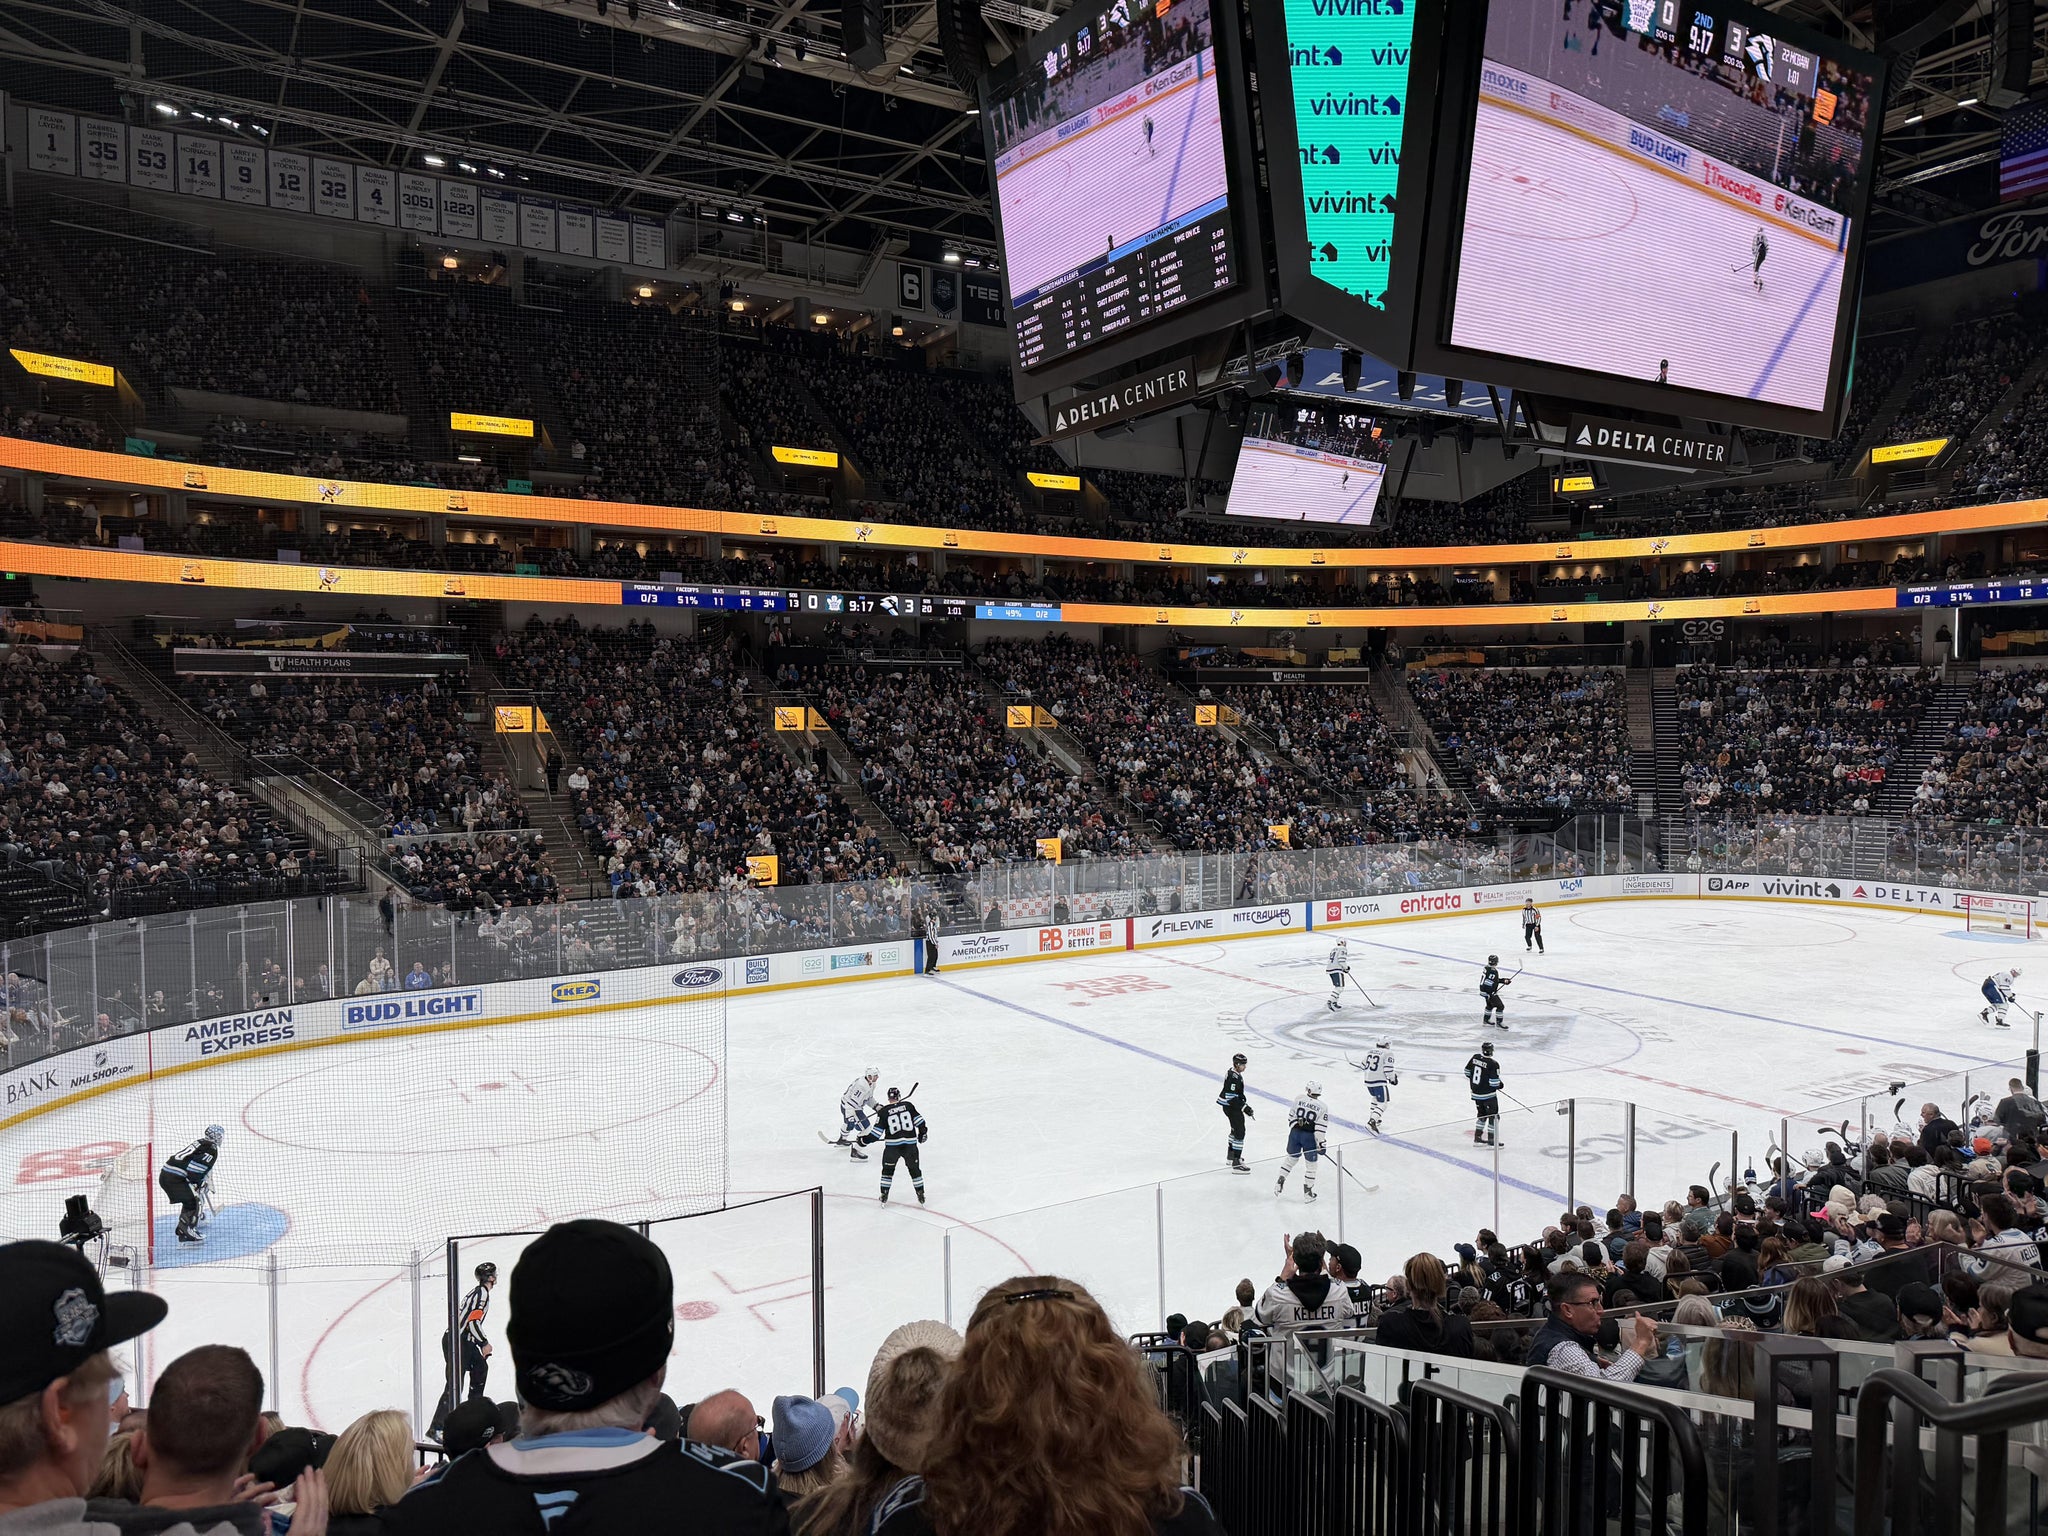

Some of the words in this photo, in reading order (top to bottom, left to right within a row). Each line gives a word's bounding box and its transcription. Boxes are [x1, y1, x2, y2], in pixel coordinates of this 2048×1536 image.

[1694, 11, 1713, 30] 2ND
[1077, 35, 1091, 56] 9:17
[1689, 26, 1713, 55] 9:17
[1731, 27, 1741, 52] 3
[1310, 92, 1379, 116] vivint
[47, 133, 57, 151] 1
[1630, 129, 1654, 151] BUD
[1655, 137, 1688, 167] LIGHT
[88, 140, 118, 162] 35
[137, 148, 166, 170] 53
[188, 157, 211, 177] 14
[238, 166, 252, 184] 9
[279, 172, 300, 192] 12
[321, 180, 347, 200] 32
[371, 188, 383, 206] 4
[402, 192, 435, 210] 3051
[1308, 191, 1376, 214] vivint
[443, 200, 476, 216] 1223
[1784, 196, 1808, 223] Ken
[1806, 207, 1836, 235] Garff
[1967, 206, 2048, 266] For
[902, 272, 920, 301] 6
[1070, 394, 1120, 425] DELTA
[1124, 369, 1189, 406] CENTER
[1596, 427, 1656, 453] DELTA
[1661, 436, 1725, 462] CENTER
[641, 593, 658, 604] 0/3
[677, 594, 699, 605] 51%
[714, 596, 724, 606] 11
[1914, 595, 1931, 605] 0/3
[1950, 592, 1973, 602] 51%
[1989, 590, 2001, 600] 11
[2019, 588, 2032, 598] 12
[740, 598, 752, 608] 12
[763, 599, 775, 609] 34
[789, 599, 800, 608] 13
[808, 595, 819, 610] 0
[849, 600, 875, 613] 9:17
[904, 599, 915, 613] 3
[921, 605, 933, 613] 20
[948, 606, 963, 616] 1:01
[1005, 608, 1022, 618] 49%
[1035, 610, 1049, 619] 0/2
[1682, 619, 1725, 636] G2G
[287, 657, 322, 670] HEALTH
[324, 659, 352, 672] PLANS
[1283, 673, 1306, 681] HEALTH
[1625, 880, 1672, 889] INGREDIENTS
[1763, 878, 1821, 897] vivint
[1400, 892, 1462, 914] entrata
[1483, 892, 1504, 900] HEALTH
[1875, 886, 1942, 904] DELTA
[1344, 903, 1380, 914] TOYOTA
[1233, 908, 1292, 926] NITECRAWLER
[1067, 926, 1096, 938] PEANUT
[1163, 918, 1214, 933] FILEVINE
[951, 945, 987, 957] AMERICA
[987, 943, 1010, 953] FIRST
[1067, 937, 1096, 948] BETTER
[880, 950, 898, 959] G2G
[748, 960, 768, 969] BUILT
[804, 959, 822, 968] G2G
[681, 970, 713, 986] Ford
[748, 974, 768, 982] TOUGH
[556, 984, 598, 1000] IKEA
[347, 1003, 402, 1025] BUD
[404, 994, 478, 1019] LIGHT
[185, 1009, 294, 1043] AMERICAN
[200, 1024, 297, 1056] EXPRESS
[1472, 1066, 1482, 1085] 8
[5, 1068, 60, 1105] BANK
[1230, 1083, 1236, 1092] 6
[887, 1111, 914, 1135] 88
[1293, 1304, 1336, 1321] KELLER
